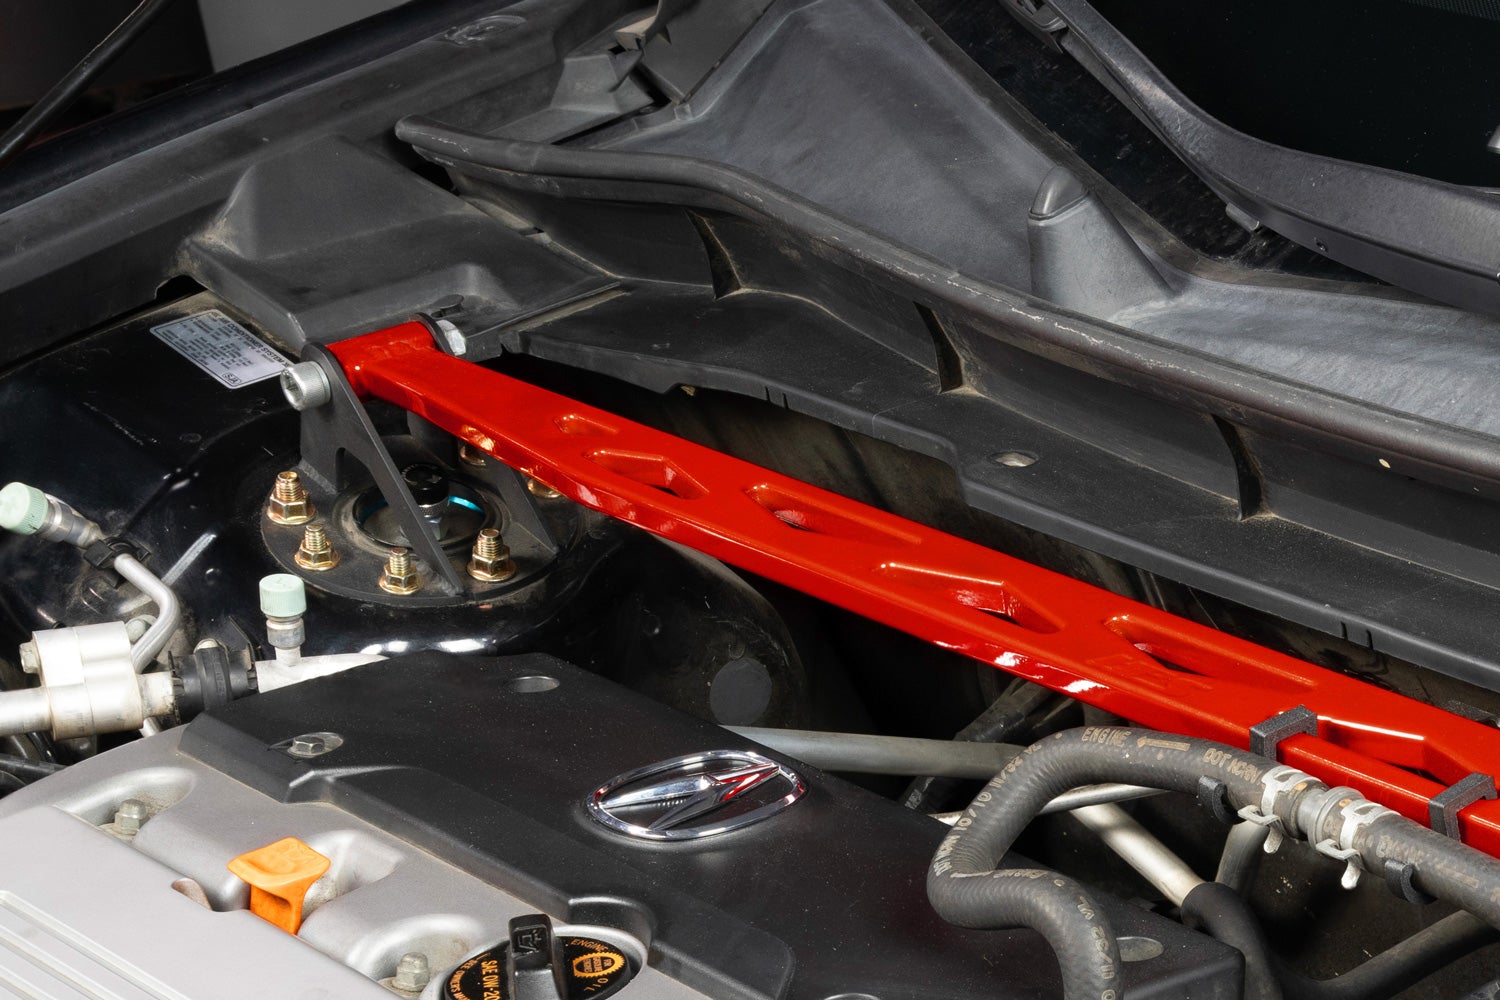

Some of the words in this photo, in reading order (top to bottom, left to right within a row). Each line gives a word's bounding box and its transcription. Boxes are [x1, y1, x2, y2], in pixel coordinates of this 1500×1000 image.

[228, 323, 264, 348] CONDITIONER
[261, 346, 284, 363] SYSTEM
[1081, 726, 1132, 748] ENGINE
[1202, 747, 1232, 768] DOT
[481, 960, 499, 975] SAE
[584, 977, 609, 991] OIL
